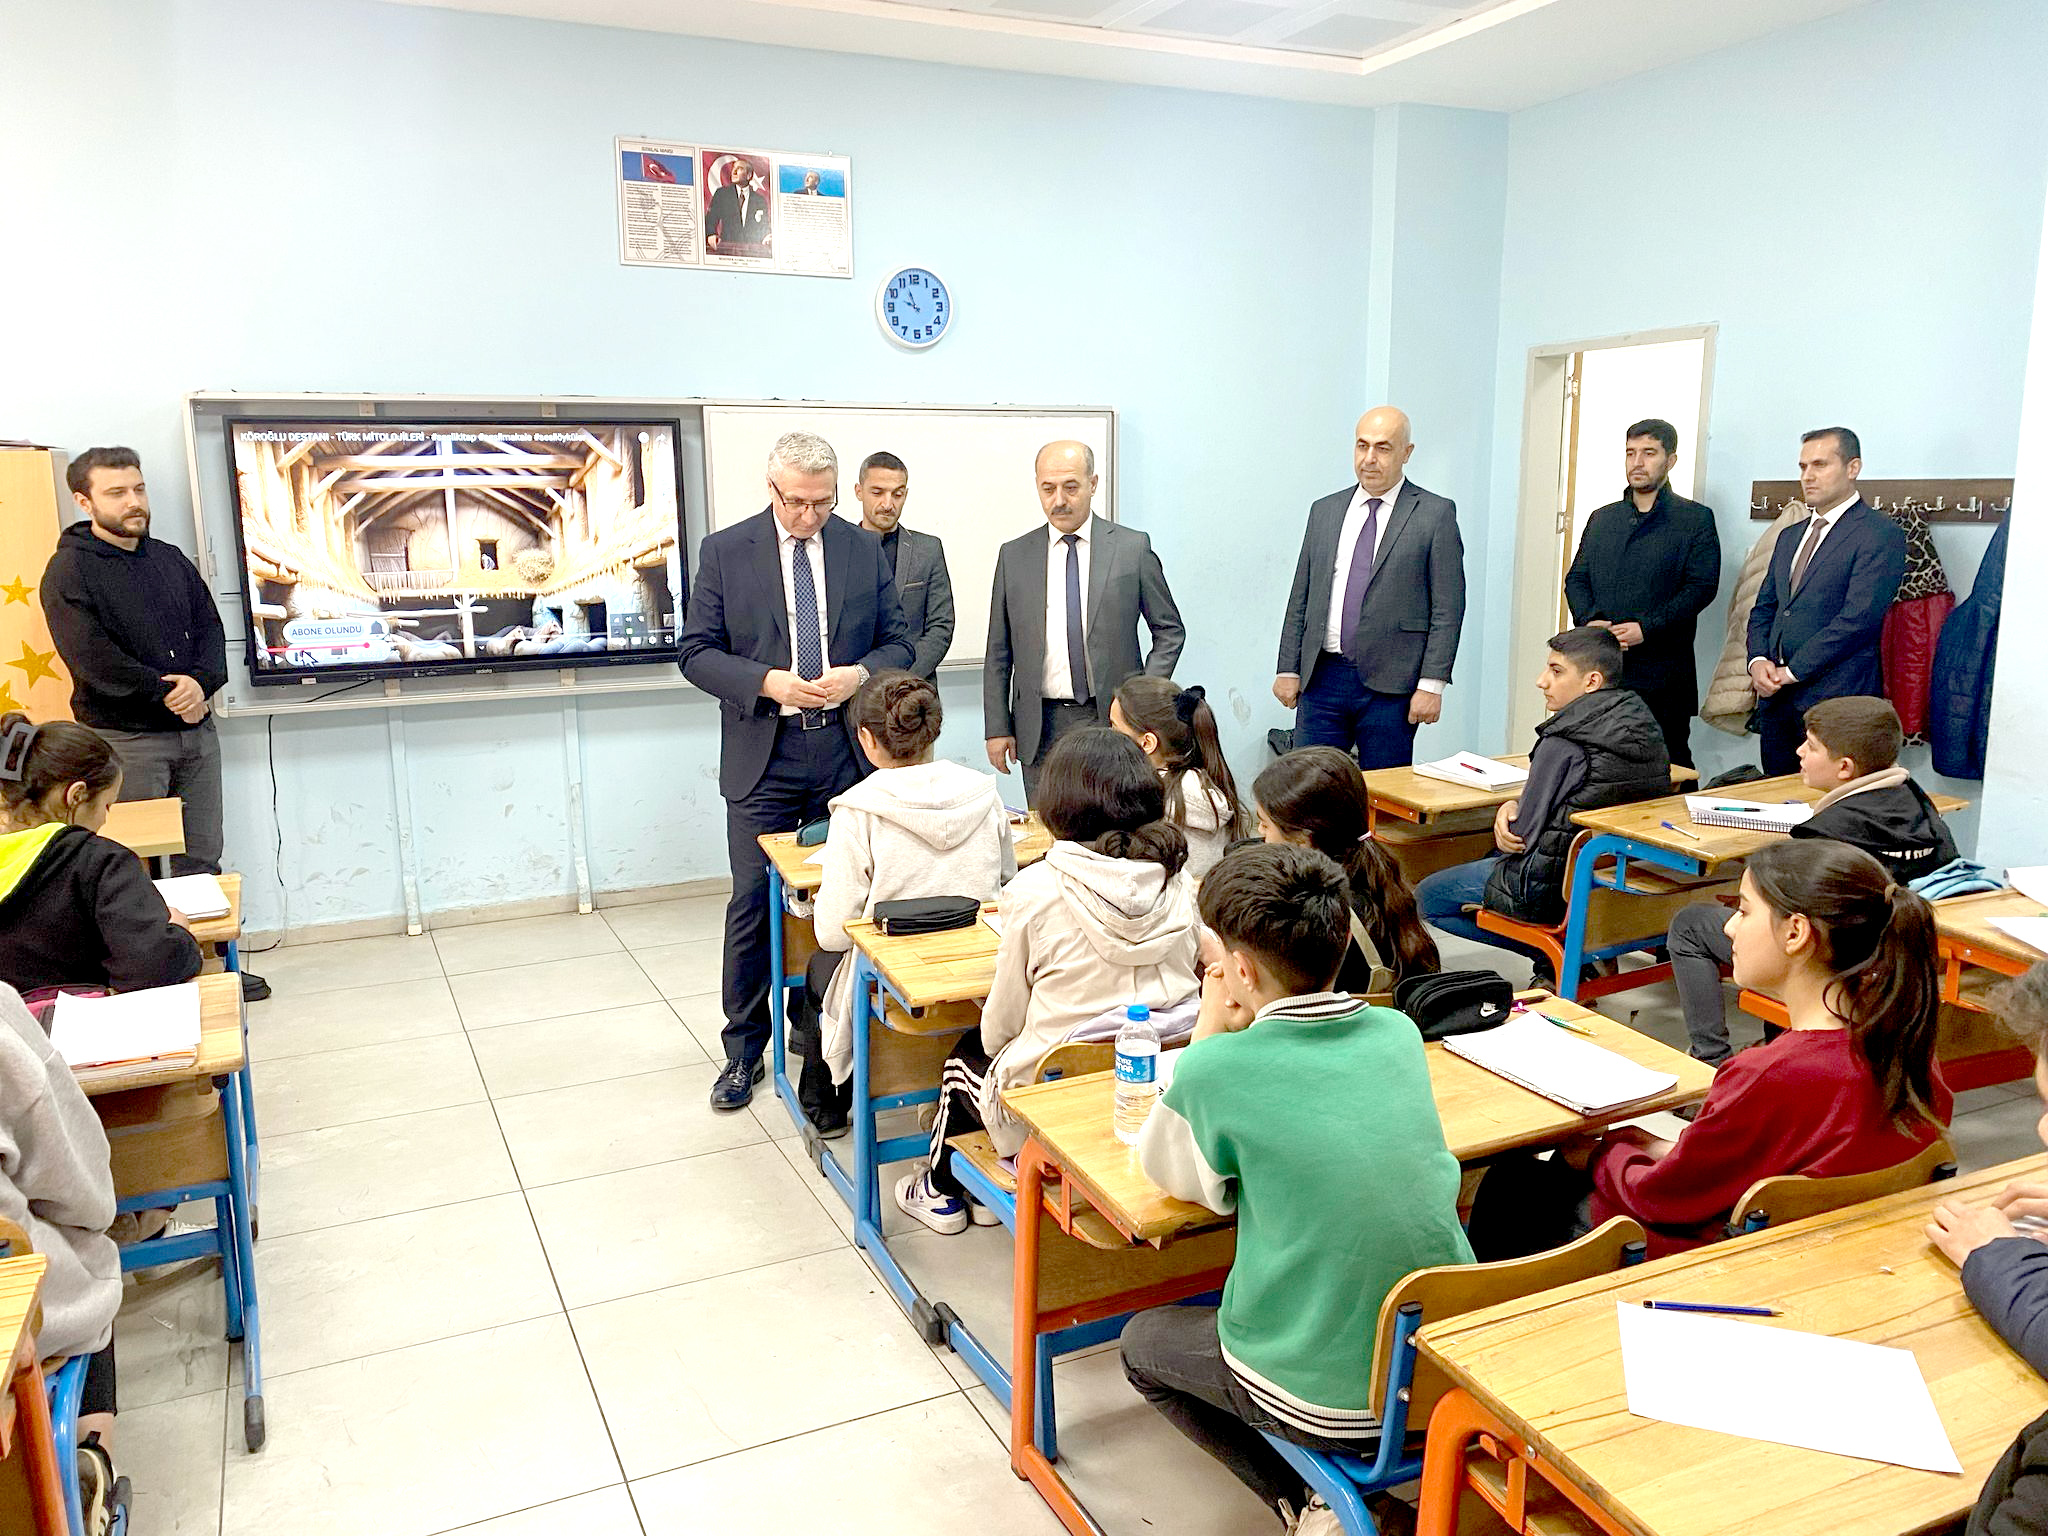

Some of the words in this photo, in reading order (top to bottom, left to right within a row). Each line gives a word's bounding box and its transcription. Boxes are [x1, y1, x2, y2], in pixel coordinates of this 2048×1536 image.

[899, 278, 906, 288] 11
[909, 274, 919, 285] 12
[924, 278, 928, 288] 1
[889, 288, 899, 299] 10
[932, 288, 939, 299] 2
[888, 302, 895, 313] 9
[936, 301, 943, 312] 3
[892, 316, 899, 326] 8
[933, 315, 941, 325] 4
[901, 325, 908, 336] 7
[913, 329, 921, 339] 6
[925, 325, 932, 336] 5
[240, 430, 286, 442] KÖROĞLU
[288, 432, 329, 442] DESTANI
[336, 431, 361, 442] TÜRK
[362, 431, 424, 442] MİTOLOJİLERİ
[292, 624, 322, 636] ABONE
[324, 622, 362, 634] OLUNDU
